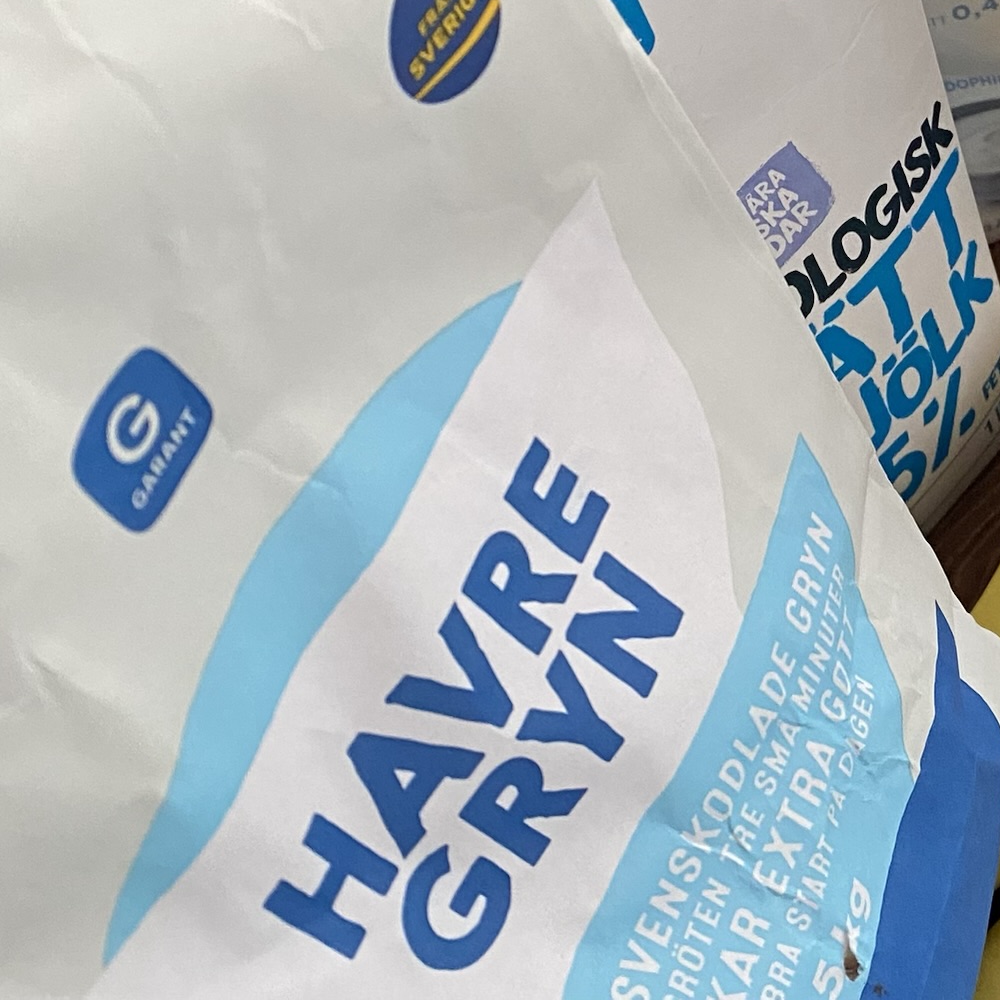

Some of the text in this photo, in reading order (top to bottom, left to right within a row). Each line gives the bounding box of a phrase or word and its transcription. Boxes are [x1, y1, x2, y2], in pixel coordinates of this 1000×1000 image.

[131, 405, 196, 511] GARANT
[262, 436, 611, 960] HAVRE
[402, 551, 685, 971] GRYN
[611, 511, 834, 1000] SVENSKODLADE GRYN
[752, 740, 837, 897] EXTRA
[819, 607, 855, 723] GOTT
[791, 562, 845, 713] MINUTER
[786, 833, 835, 932] START
[838, 674, 876, 778] DAGEN
